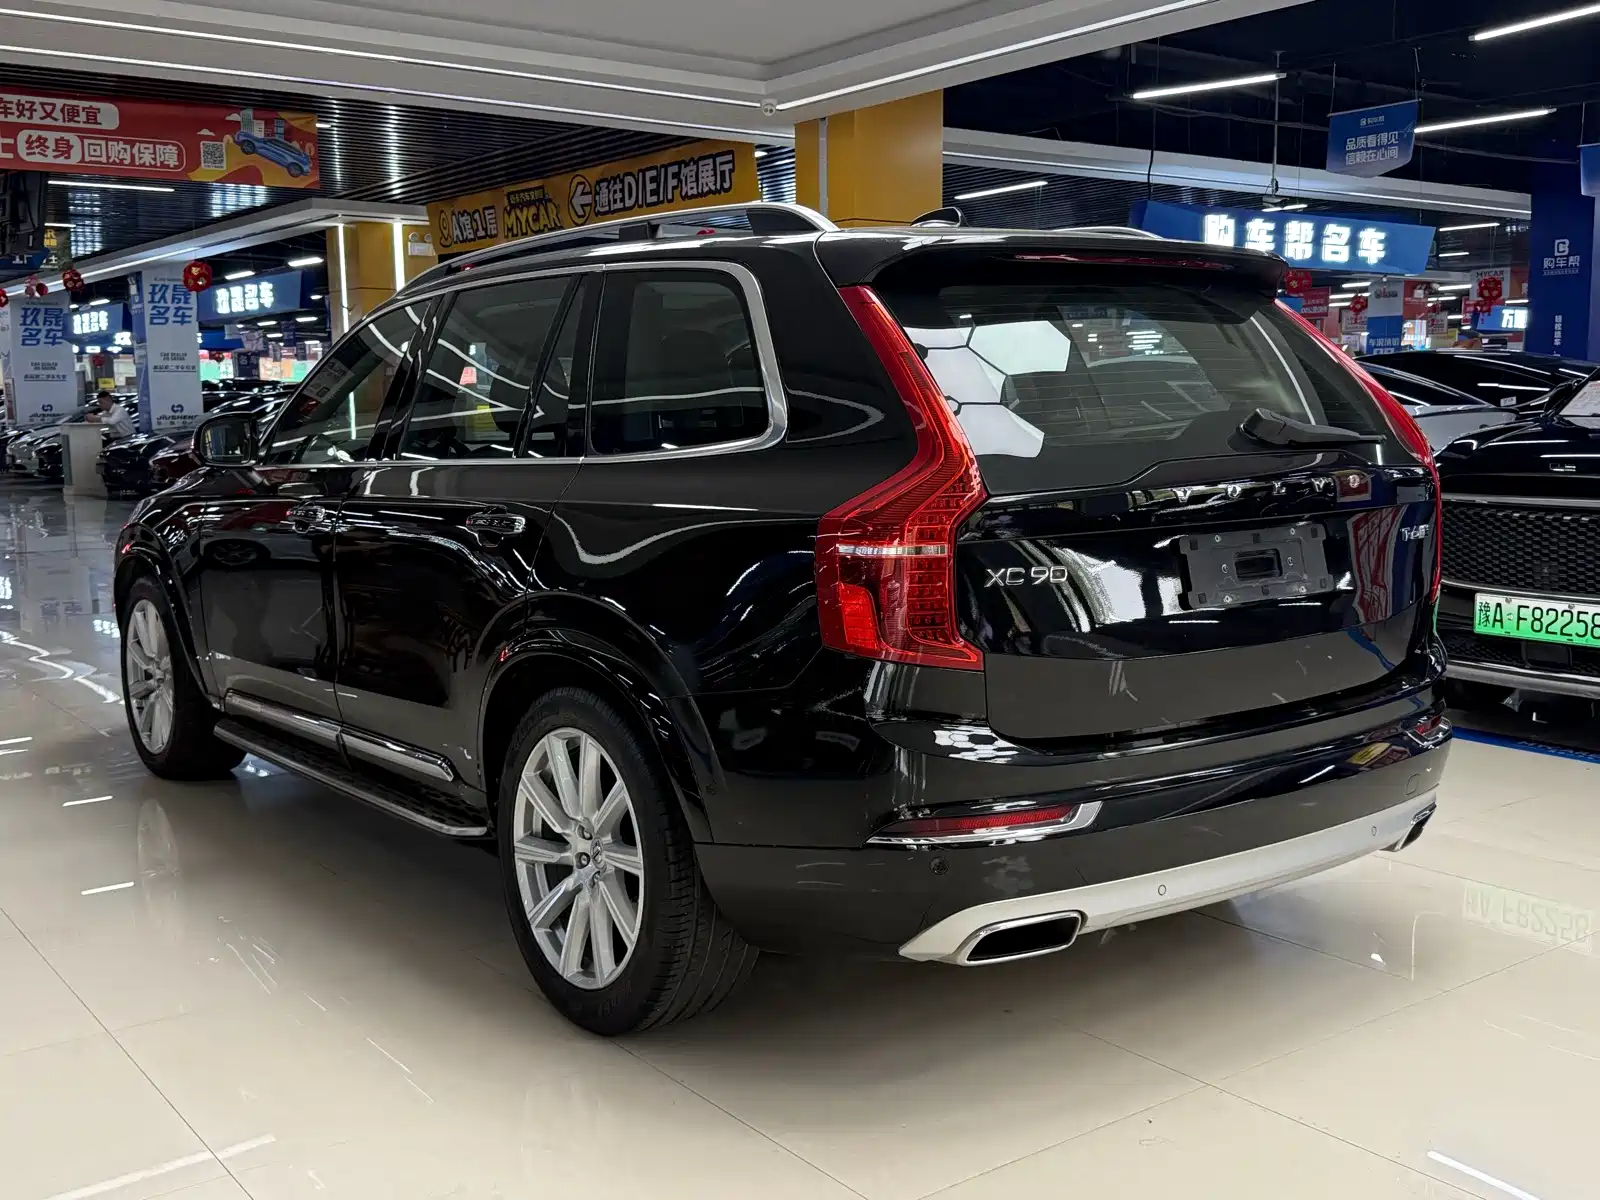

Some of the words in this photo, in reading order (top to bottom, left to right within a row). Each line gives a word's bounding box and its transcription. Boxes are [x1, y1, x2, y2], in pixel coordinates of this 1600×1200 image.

[1346, 131, 1399, 151] 品质看得见
[1346, 146, 1399, 165] 信赖在心间
[503, 202, 561, 238] MYCAR
[1203, 213, 1388, 266] 购车帮名车
[1543, 256, 1580, 269] 购车帮
[149, 305, 193, 326] 名车
[21, 327, 63, 347] 名车
